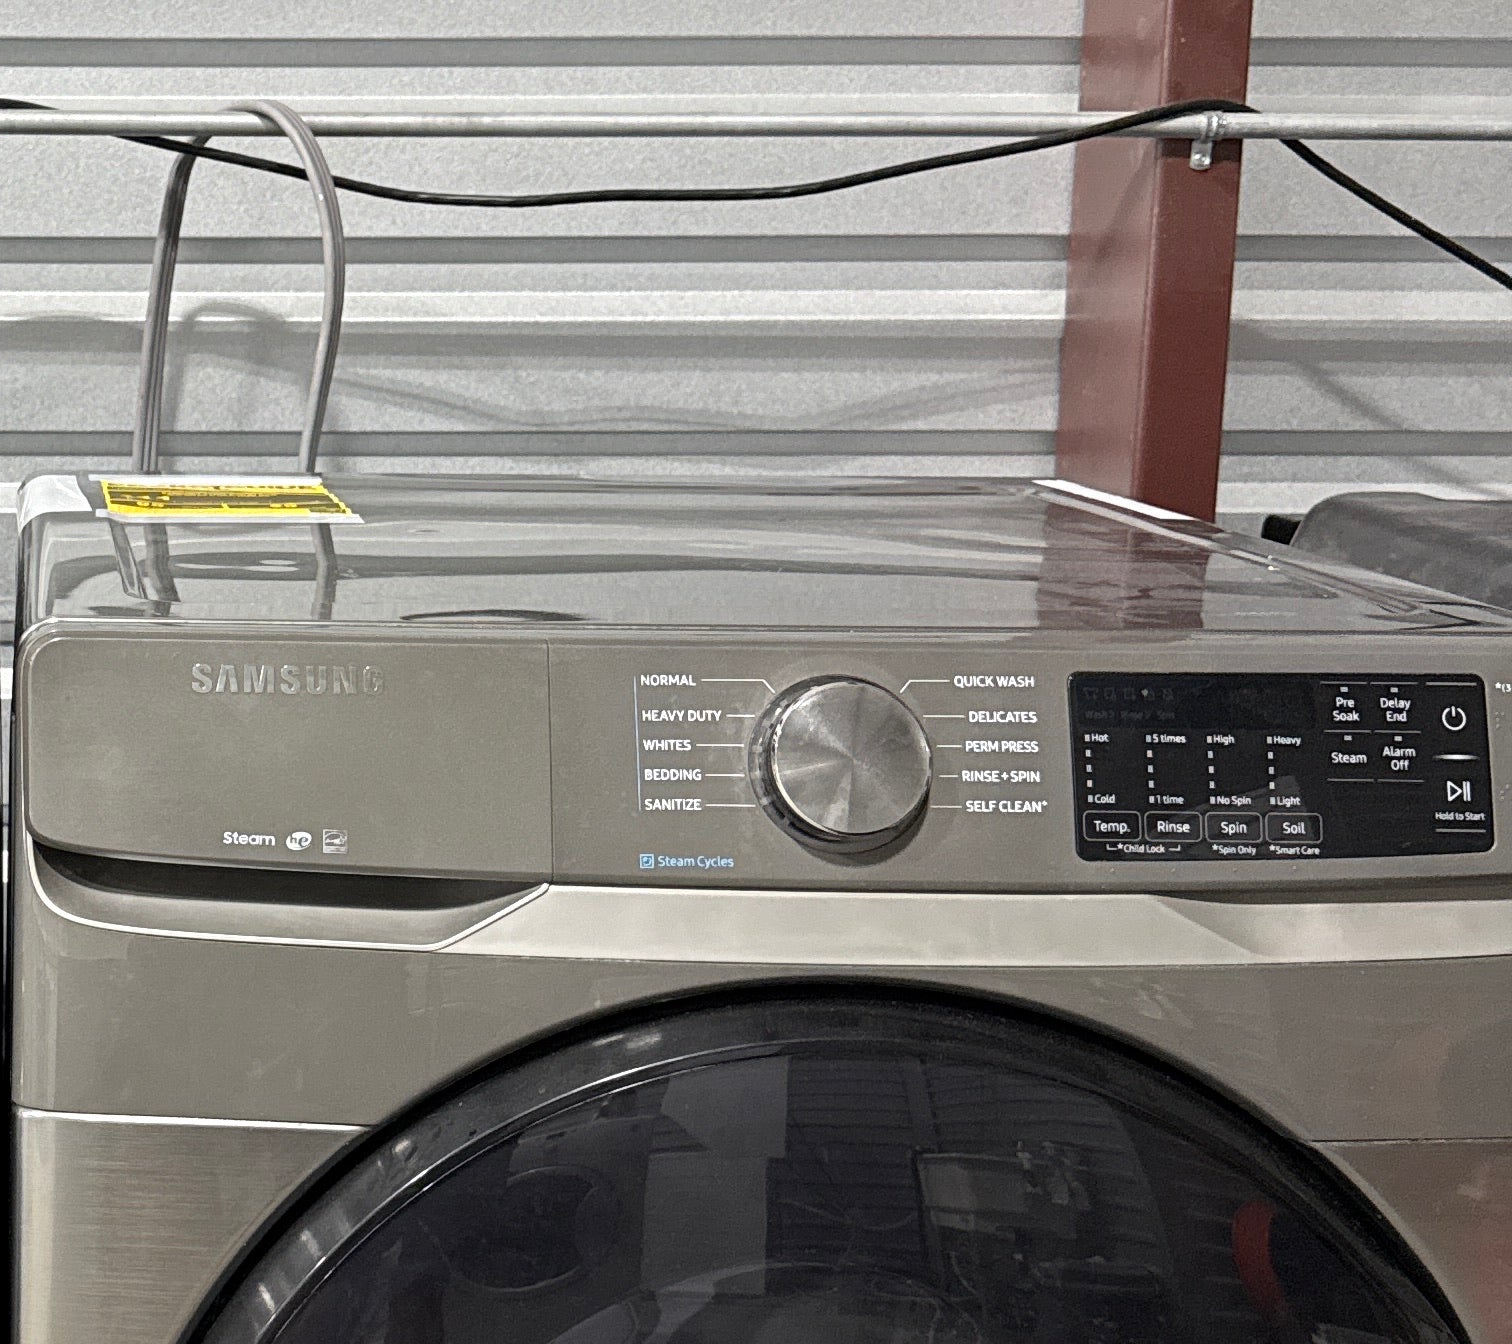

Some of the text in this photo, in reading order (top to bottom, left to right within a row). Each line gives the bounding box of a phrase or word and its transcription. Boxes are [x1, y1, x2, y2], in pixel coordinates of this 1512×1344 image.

[191, 663, 384, 695] SAMSUNG
[640, 675, 696, 686] NORMAL
[954, 676, 1035, 688] QUICK WASH
[1336, 697, 1355, 708] Pre
[1380, 697, 1411, 710] Delay
[642, 710, 722, 721] HEAVY DUTY
[968, 711, 1038, 723] DELICATES
[1332, 710, 1360, 722] Soak
[1386, 711, 1407, 722] End
[1091, 733, 1109, 743] Hot
[1152, 734, 1186, 743] 5 times
[1213, 734, 1235, 746] High
[1273, 735, 1301, 747] Heavy
[643, 739, 691, 751] WHITES
[965, 741, 1039, 752] PERM PRESS
[1382, 746, 1416, 757] Alarm
[1331, 752, 1367, 763] Steam
[1390, 760, 1409, 771] Off
[644, 769, 702, 780] BEDDING
[644, 799, 702, 810] SANITIZE
[1094, 794, 1116, 804] Cold
[1156, 795, 1184, 804] 1 time
[1216, 795, 1252, 807] No Spin
[1276, 796, 1301, 807] Light
[965, 801, 997, 812] SELF
[1435, 811, 1486, 821] Hold to Start
[1093, 820, 1131, 834] Temp.
[1157, 820, 1191, 833] Rinse
[1220, 821, 1247, 836] Spin
[1282, 821, 1306, 834] Soil
[223, 831, 276, 846] Steam
[1146, 844, 1165, 853] Lock
[1237, 845, 1257, 856] Only
[1301, 845, 1320, 855] Care
[657, 855, 735, 869] Steam Cycles
